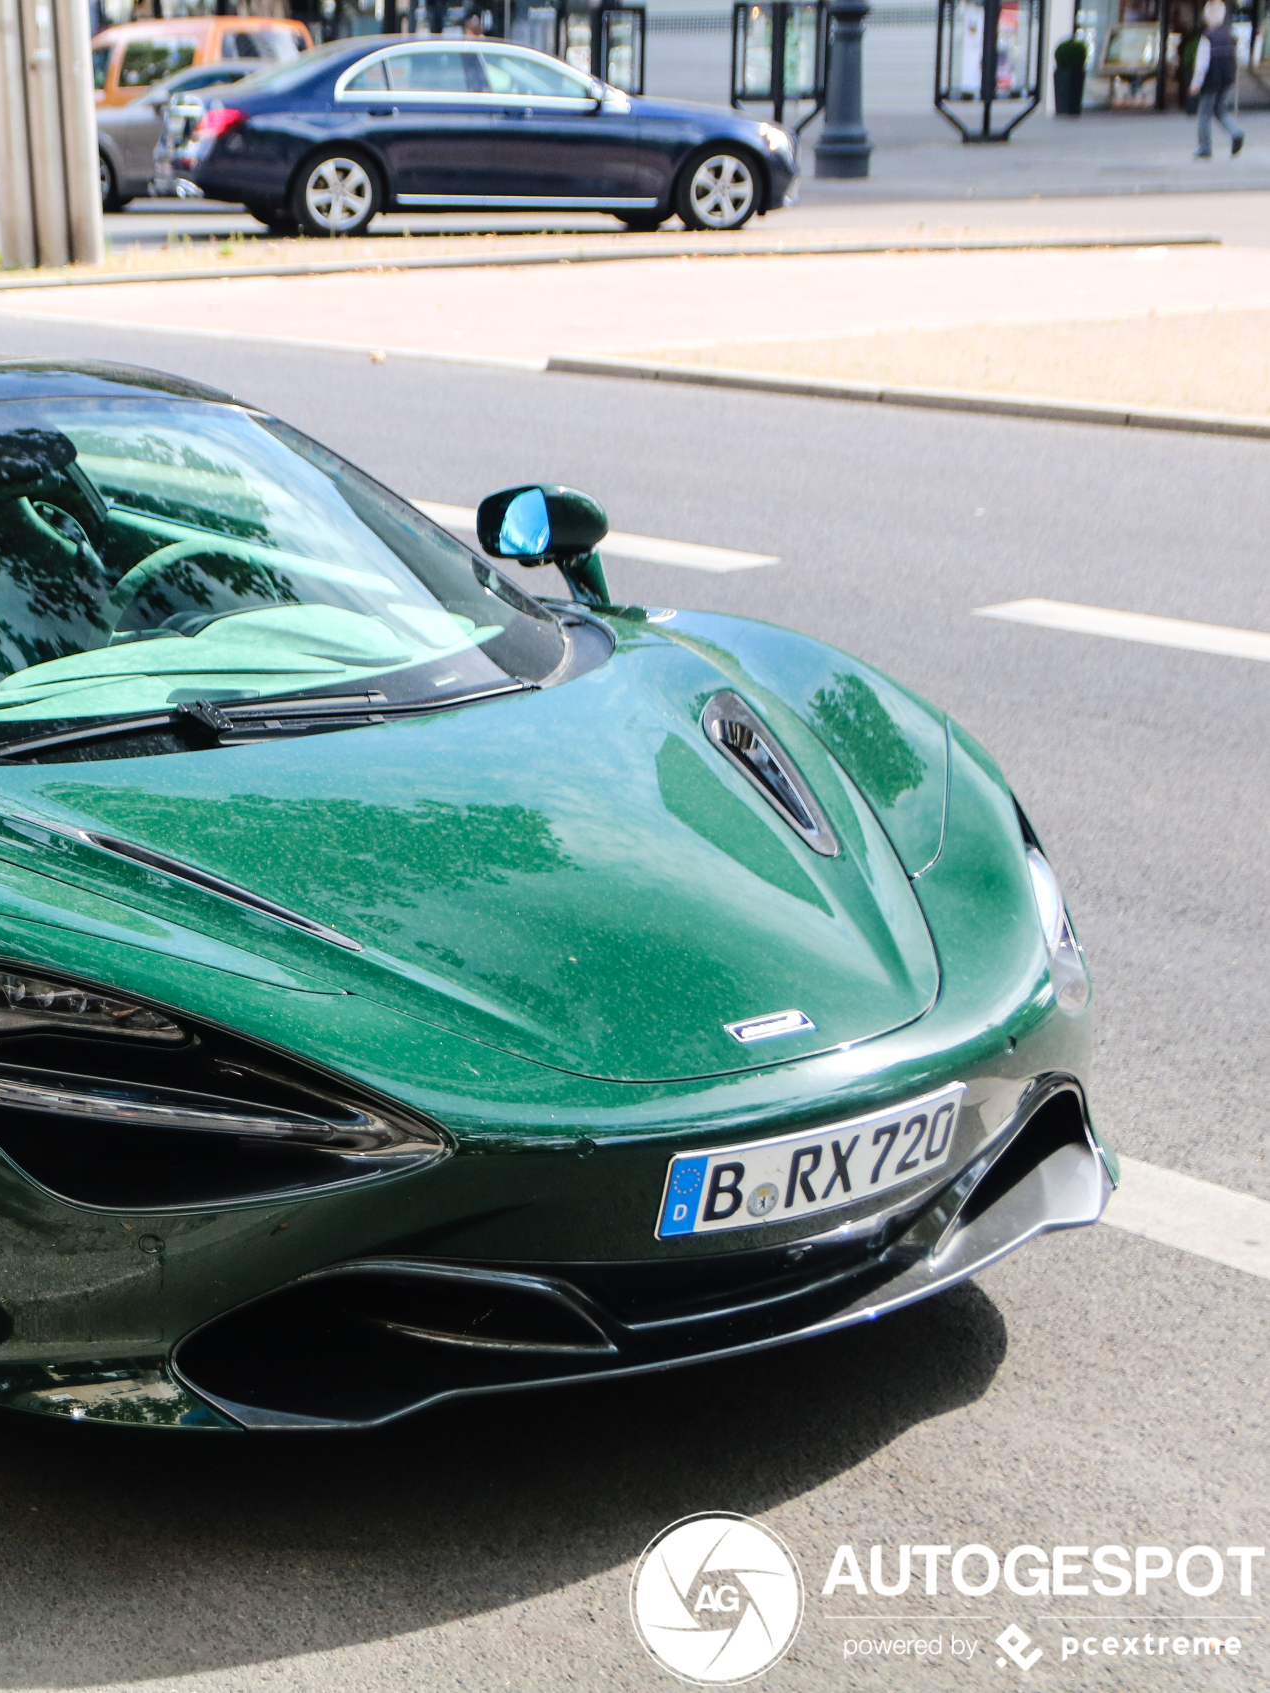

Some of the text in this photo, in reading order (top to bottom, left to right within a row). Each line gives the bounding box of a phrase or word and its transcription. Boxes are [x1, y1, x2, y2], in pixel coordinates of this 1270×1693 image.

[672, 1102, 956, 1223] D B RX 720
